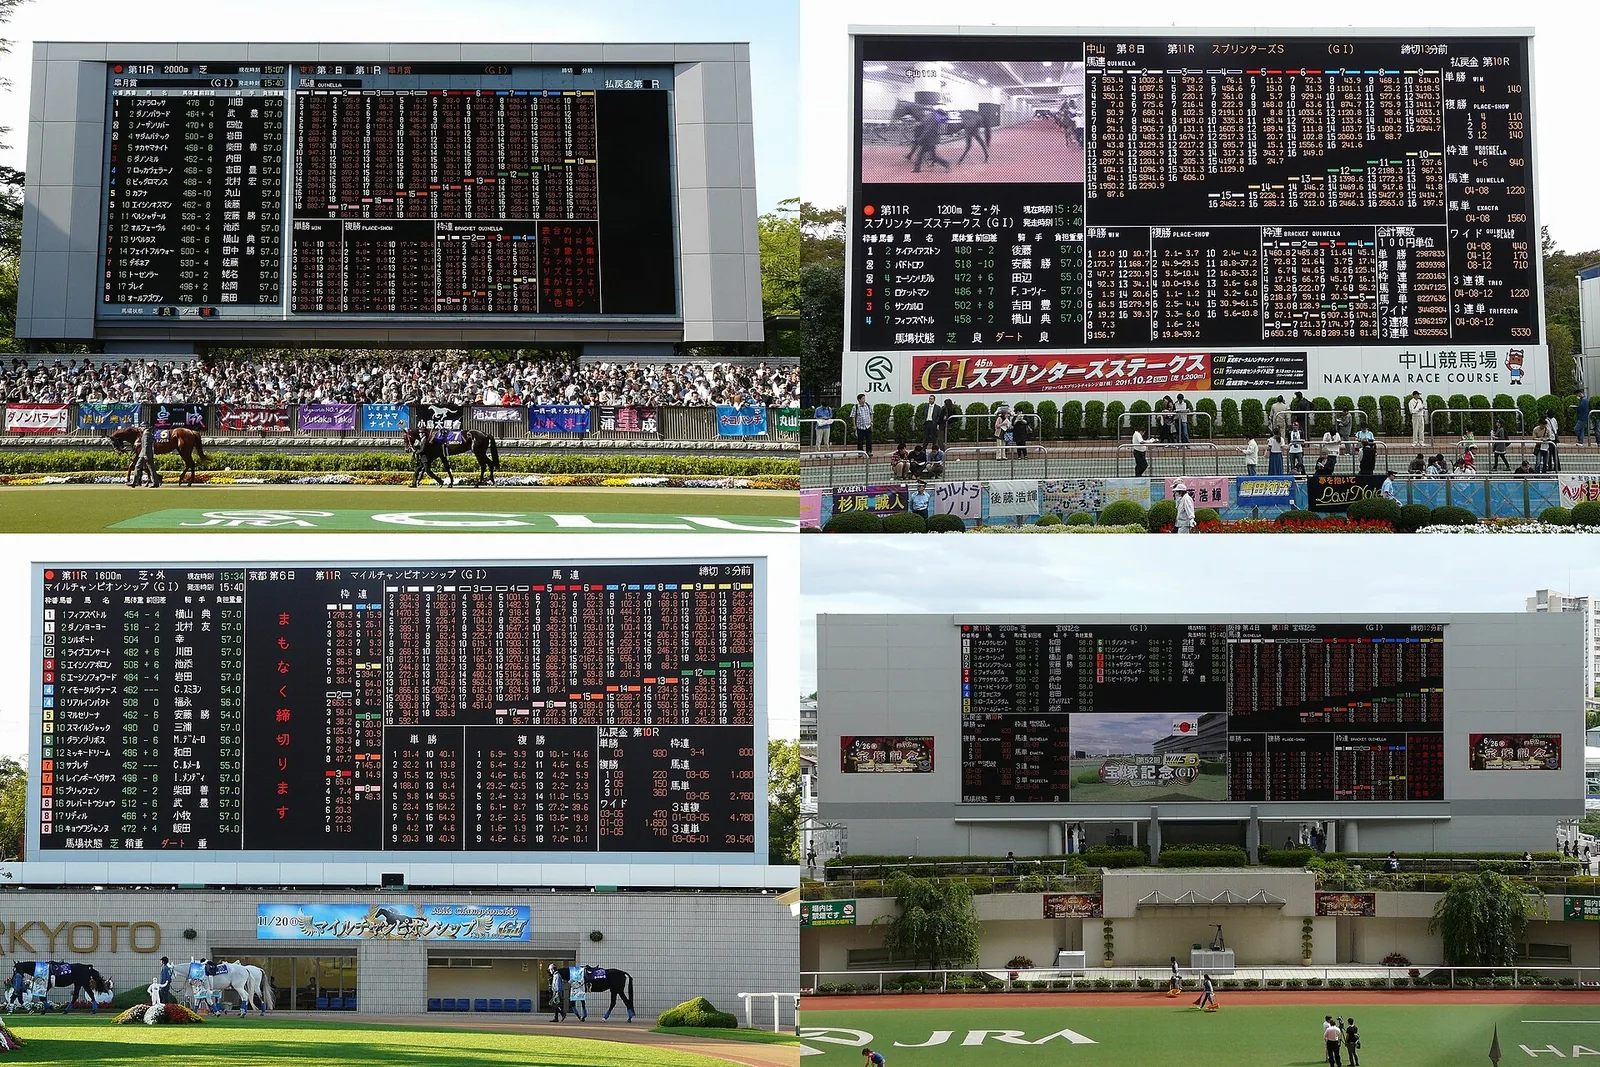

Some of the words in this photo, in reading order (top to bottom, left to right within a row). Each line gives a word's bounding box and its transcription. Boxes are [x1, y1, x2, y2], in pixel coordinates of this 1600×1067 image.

[1086, 44, 1105, 54] 中山
[1116, 44, 1145, 55] 第8日
[1167, 44, 1195, 55] 第11R
[1212, 44, 1285, 54] スプリンターズS
[1450, 57, 1479, 67] 払戻金
[1483, 57, 1510, 67] 第10R
[128, 65, 154, 74] 第11R
[199, 66, 207, 74] 芝
[264, 66, 284, 74] 15:07
[1508, 85, 1521, 93] 140
[1465, 186, 1489, 194] 04-08
[1506, 186, 1525, 194] 1220
[881, 205, 910, 215] 第11R
[938, 206, 962, 214] 1200m
[1054, 205, 1083, 214] 15:24
[1054, 218, 1083, 227] 15:40
[1508, 214, 1526, 222] 1560
[1377, 227, 1415, 237] 合計票数
[1454, 289, 1493, 297] 04-08-12
[1510, 289, 1529, 297] 1220
[1511, 328, 1531, 336] 5330
[996, 333, 1022, 343] ダート
[974, 359, 993, 367] 45th
[1400, 351, 1497, 369] 中山競馬場
[920, 358, 971, 392] GI
[967, 355, 1204, 389] スプリンターズステークス
[1324, 373, 1400, 384] NAKAYAMA
[1408, 373, 1441, 383] RACE
[1448, 372, 1499, 382] COURSE
[1116, 375, 1153, 385] 2011.10.2
[865, 383, 892, 393] JRA
[303, 415, 331, 423] Yutaka
[160, 430, 168, 438] 6
[453, 432, 459, 440] 7
[936, 482, 980, 500] ウルトラ
[1316, 486, 1349, 504] Last
[1562, 484, 1600, 501] ヘッドラ
[991, 491, 1037, 504] 後藤浩輝
[838, 496, 868, 511] 杉原
[875, 494, 905, 510] 誠人
[947, 501, 971, 515] ノリ
[179, 519, 318, 527] JRA
[699, 566, 718, 575] 締切
[62, 571, 88, 580] 第11R
[249, 571, 267, 580] 京都
[270, 571, 295, 580] 第6日
[316, 571, 341, 580] 第11R
[219, 583, 243, 591] 15:40
[276, 612, 291, 819] まもなく締切ります
[600, 728, 628, 737] 払戻金
[633, 728, 659, 737] 第10R
[855, 740, 870, 749] 6/26
[1484, 738, 1498, 747] 6/26
[601, 800, 627, 808] ワイド
[672, 802, 700, 812] 3連複
[258, 917, 289, 926] 11/20
[315, 919, 478, 938] マイルチャンピオンシップ
[0, 921, 161, 955] KYOTO
[893, 1029, 1099, 1048] JRA
